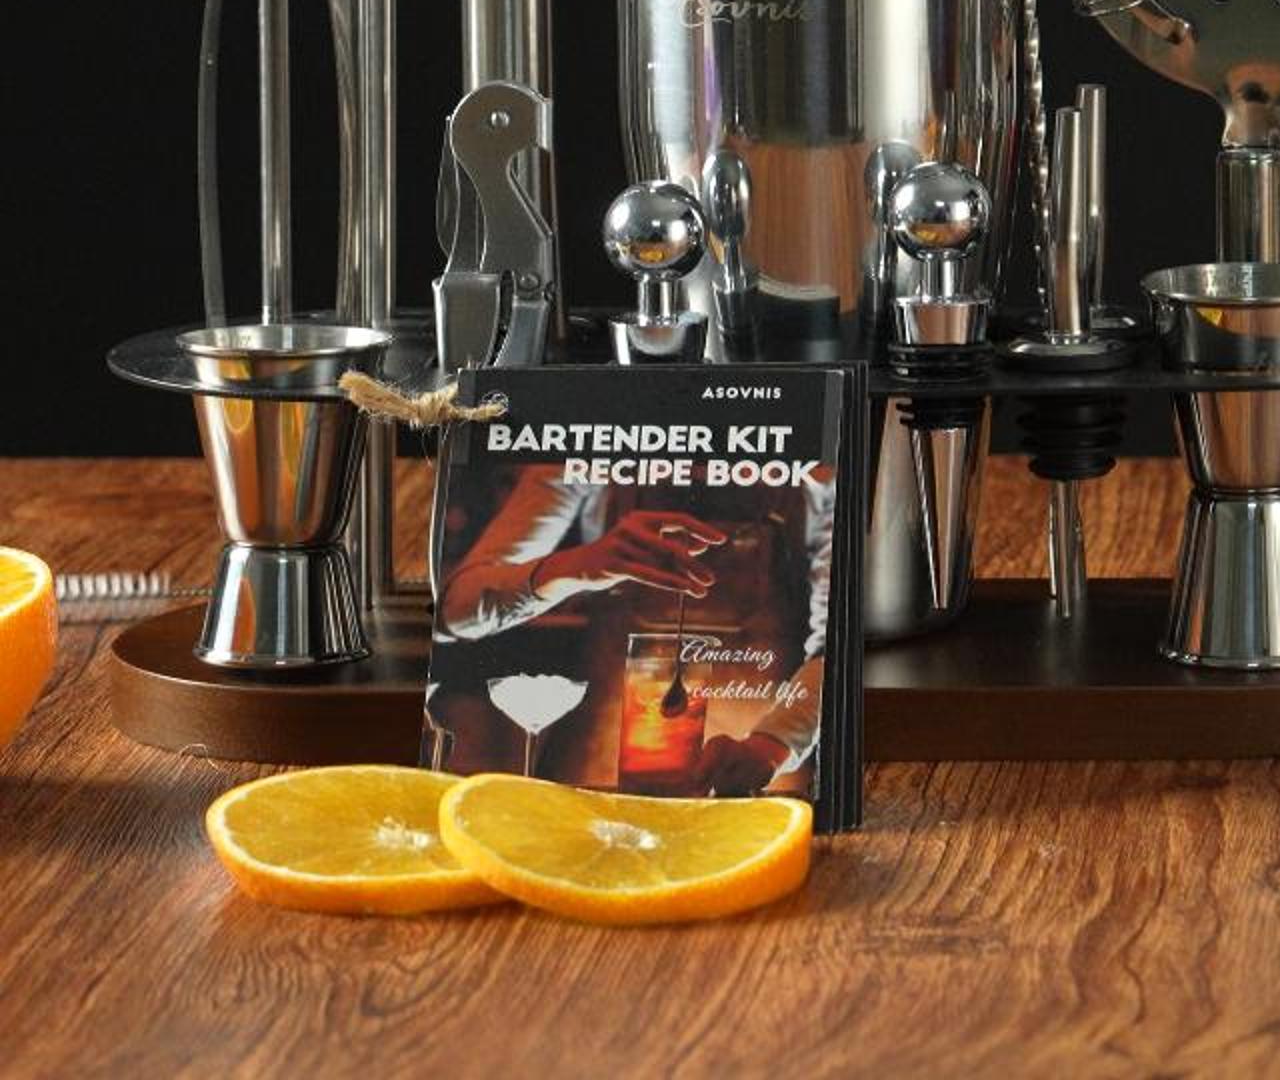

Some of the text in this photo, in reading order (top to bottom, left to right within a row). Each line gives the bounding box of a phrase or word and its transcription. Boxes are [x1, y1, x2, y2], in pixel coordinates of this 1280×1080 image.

[702, 386, 782, 400] ASOVNIS
[487, 424, 793, 453] BARTENDER KIT
[563, 458, 821, 488] RECIPE BOOK
[679, 639, 776, 671] Amazing
[690, 679, 809, 709] cocktail life
